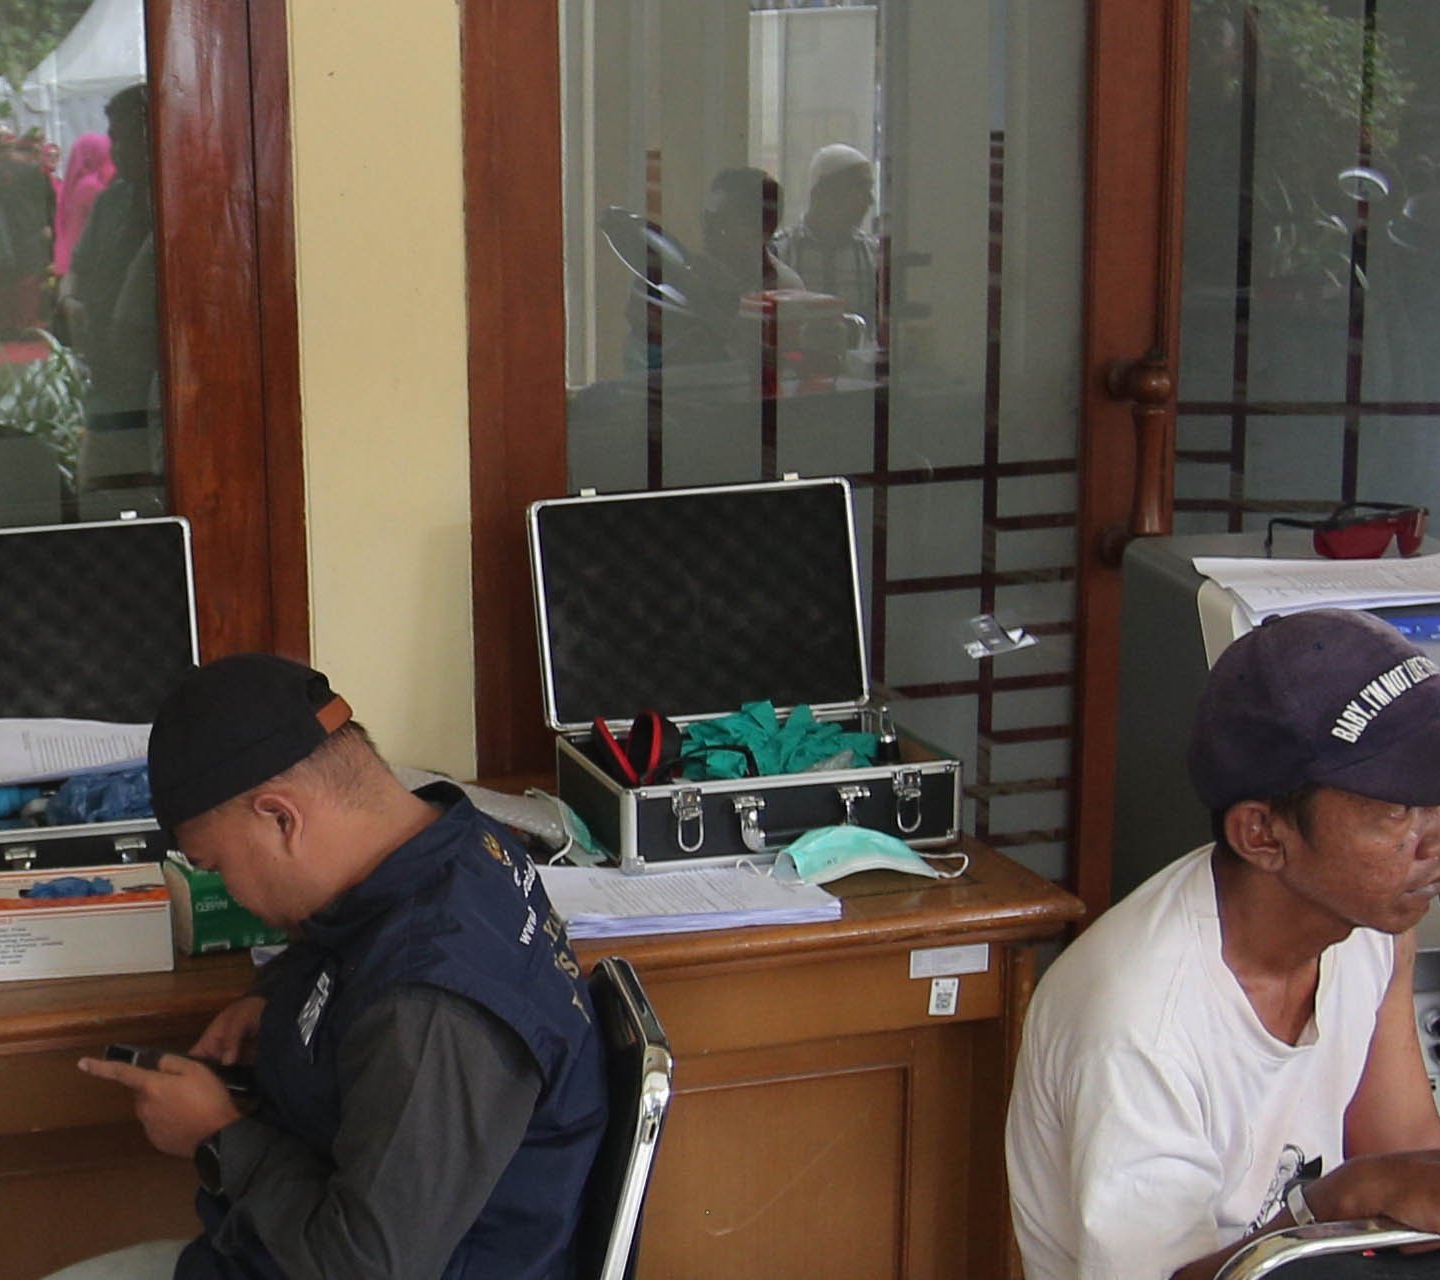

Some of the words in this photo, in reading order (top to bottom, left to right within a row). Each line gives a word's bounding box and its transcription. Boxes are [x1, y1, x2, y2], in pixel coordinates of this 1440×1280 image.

[1331, 700, 1378, 743] BABY,
[1359, 680, 1393, 711] I'M
[1378, 665, 1412, 698] NOT
